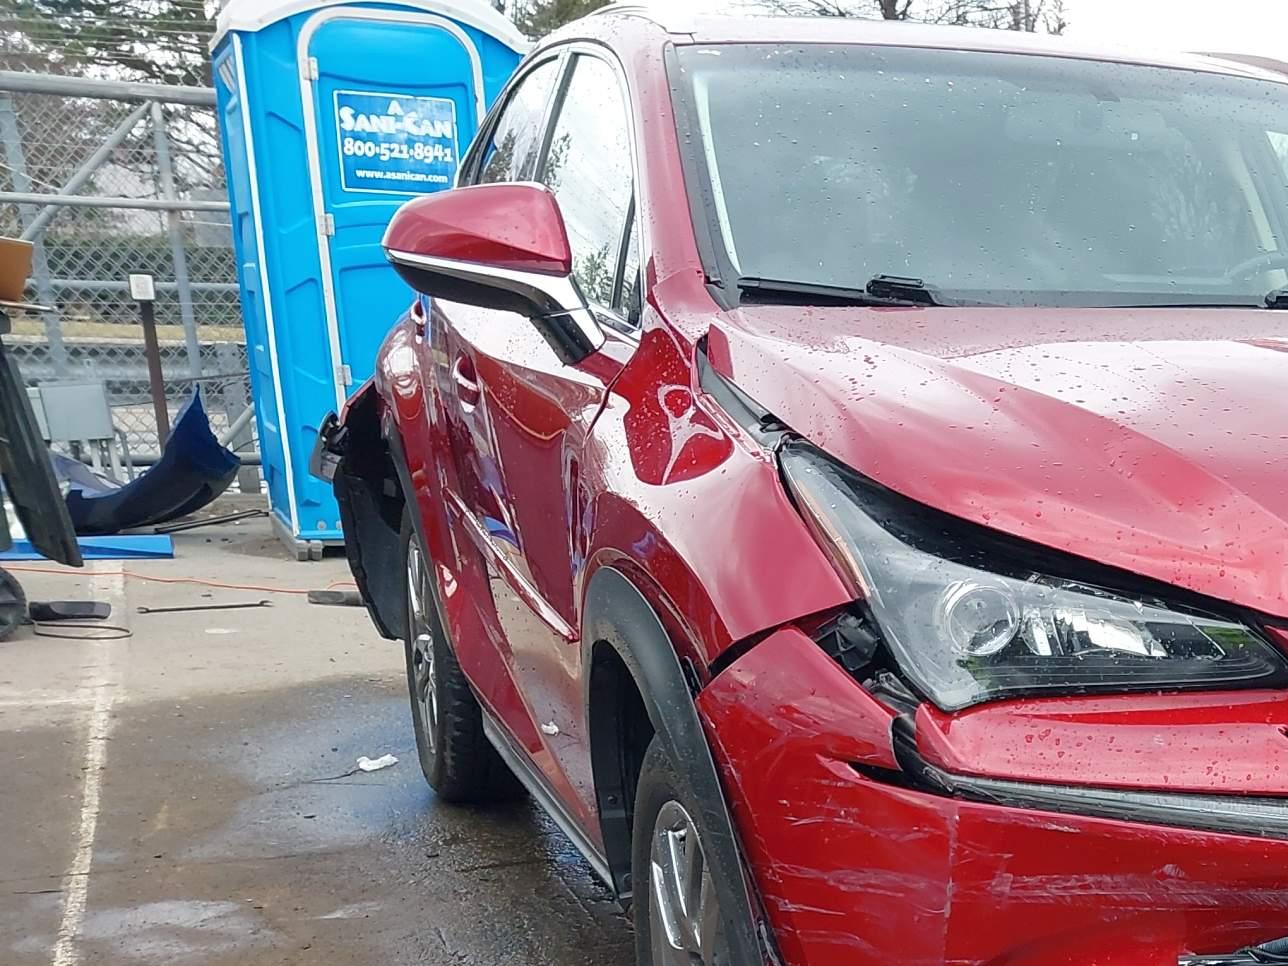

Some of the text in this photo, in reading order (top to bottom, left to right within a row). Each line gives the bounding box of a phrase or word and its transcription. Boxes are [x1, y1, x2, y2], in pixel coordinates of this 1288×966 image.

[387, 100, 404, 116] A
[339, 106, 453, 139] SANI-CAN
[355, 169, 449, 184] www.asanican.com
